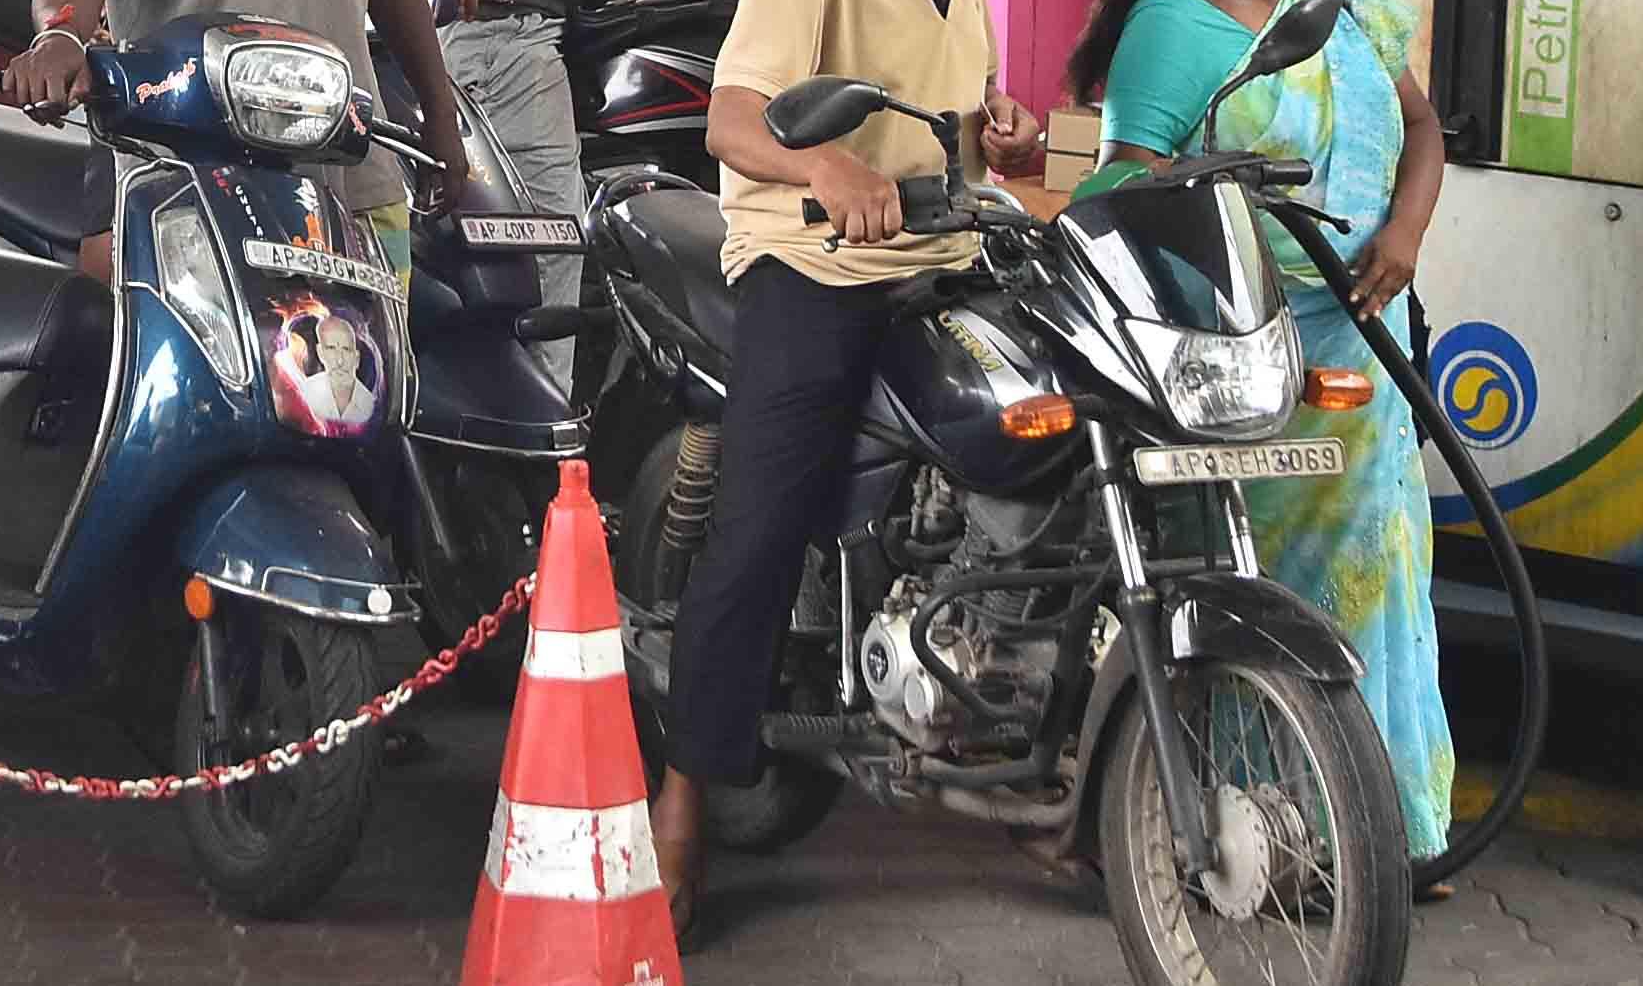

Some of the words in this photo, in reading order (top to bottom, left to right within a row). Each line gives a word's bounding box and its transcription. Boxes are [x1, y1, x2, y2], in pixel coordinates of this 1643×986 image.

[478, 222, 496, 241] AP
[542, 222, 578, 241] 1150
[271, 245, 294, 268] AP
